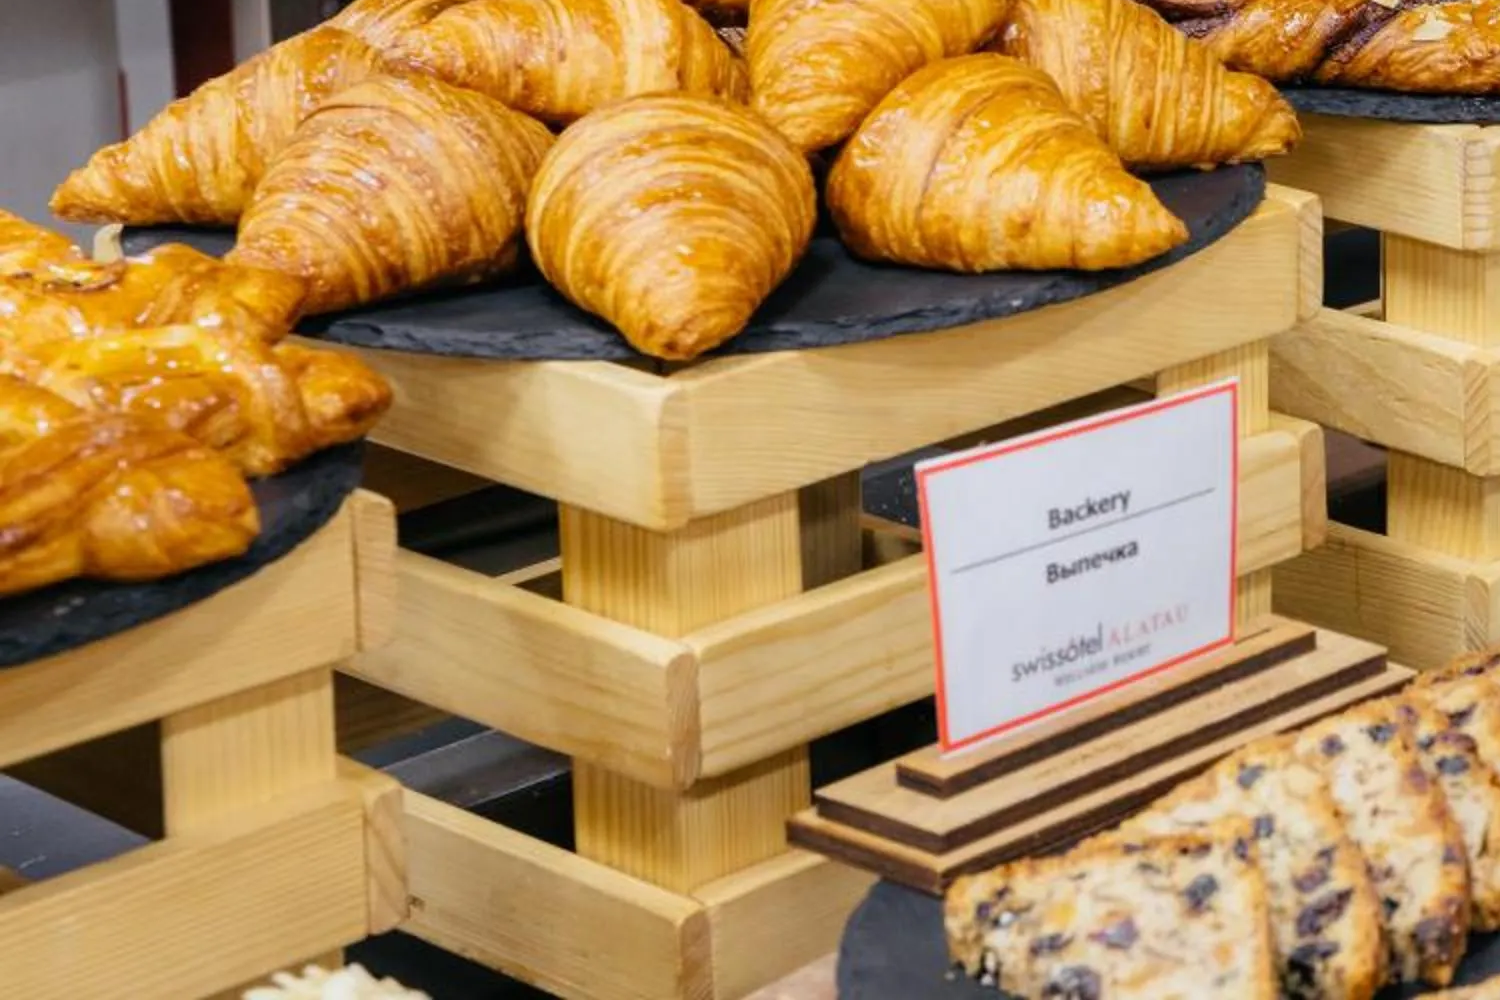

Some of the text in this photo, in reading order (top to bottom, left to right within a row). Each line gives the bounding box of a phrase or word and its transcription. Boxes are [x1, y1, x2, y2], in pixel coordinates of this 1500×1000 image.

[1047, 490, 1131, 531] Backery
[1046, 540, 1139, 584] Выпечка
[1108, 603, 1188, 647] ALATAU
